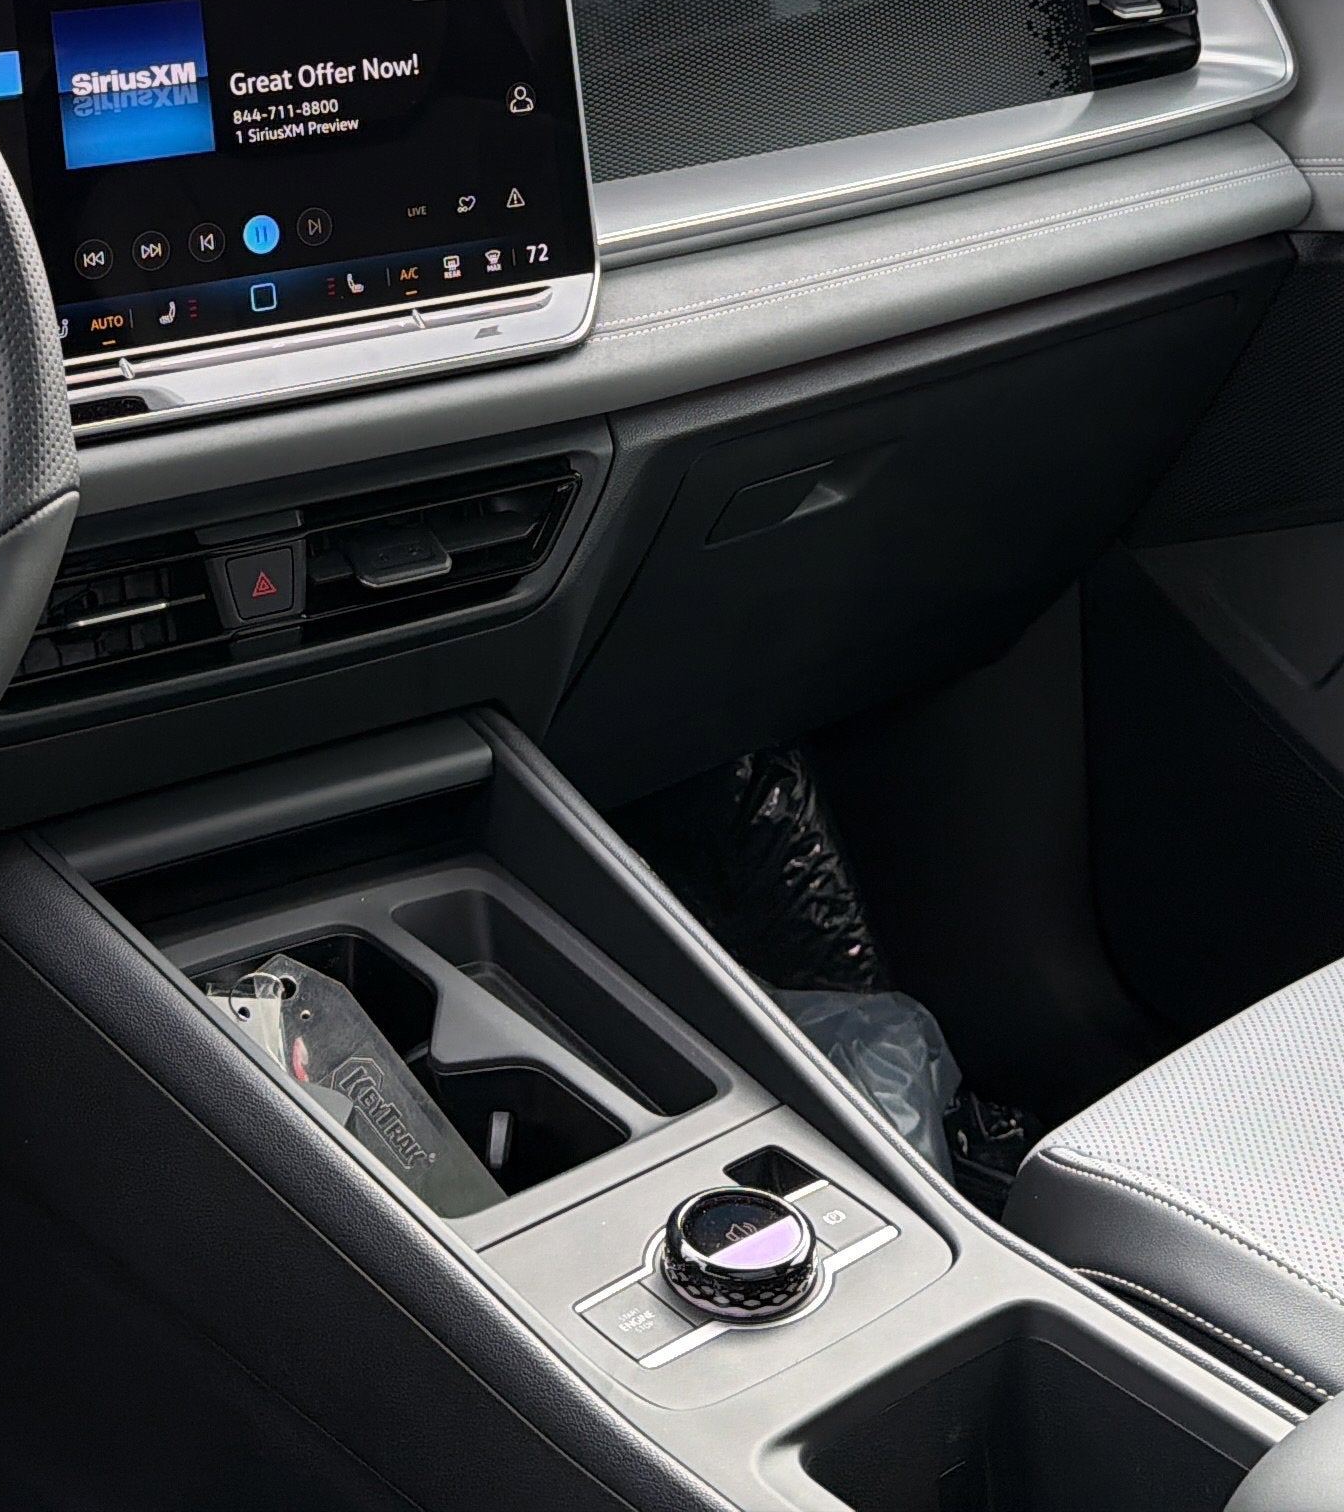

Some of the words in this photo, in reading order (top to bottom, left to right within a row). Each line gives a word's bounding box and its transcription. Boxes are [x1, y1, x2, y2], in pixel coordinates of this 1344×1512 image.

[71, 61, 197, 96] SiriusXM
[230, 69, 293, 96] Great
[298, 61, 356, 88] Offer
[362, 53, 420, 81] Now!
[233, 99, 339, 125] 844-711-8800
[235, 130, 243, 144] 1
[248, 123, 305, 143] SiriusXM
[308, 118, 359, 136] Preview
[407, 205, 427, 217] LIVE
[526, 243, 550, 264] 72
[399, 266, 419, 281] A/C
[90, 315, 124, 332] AUTO
